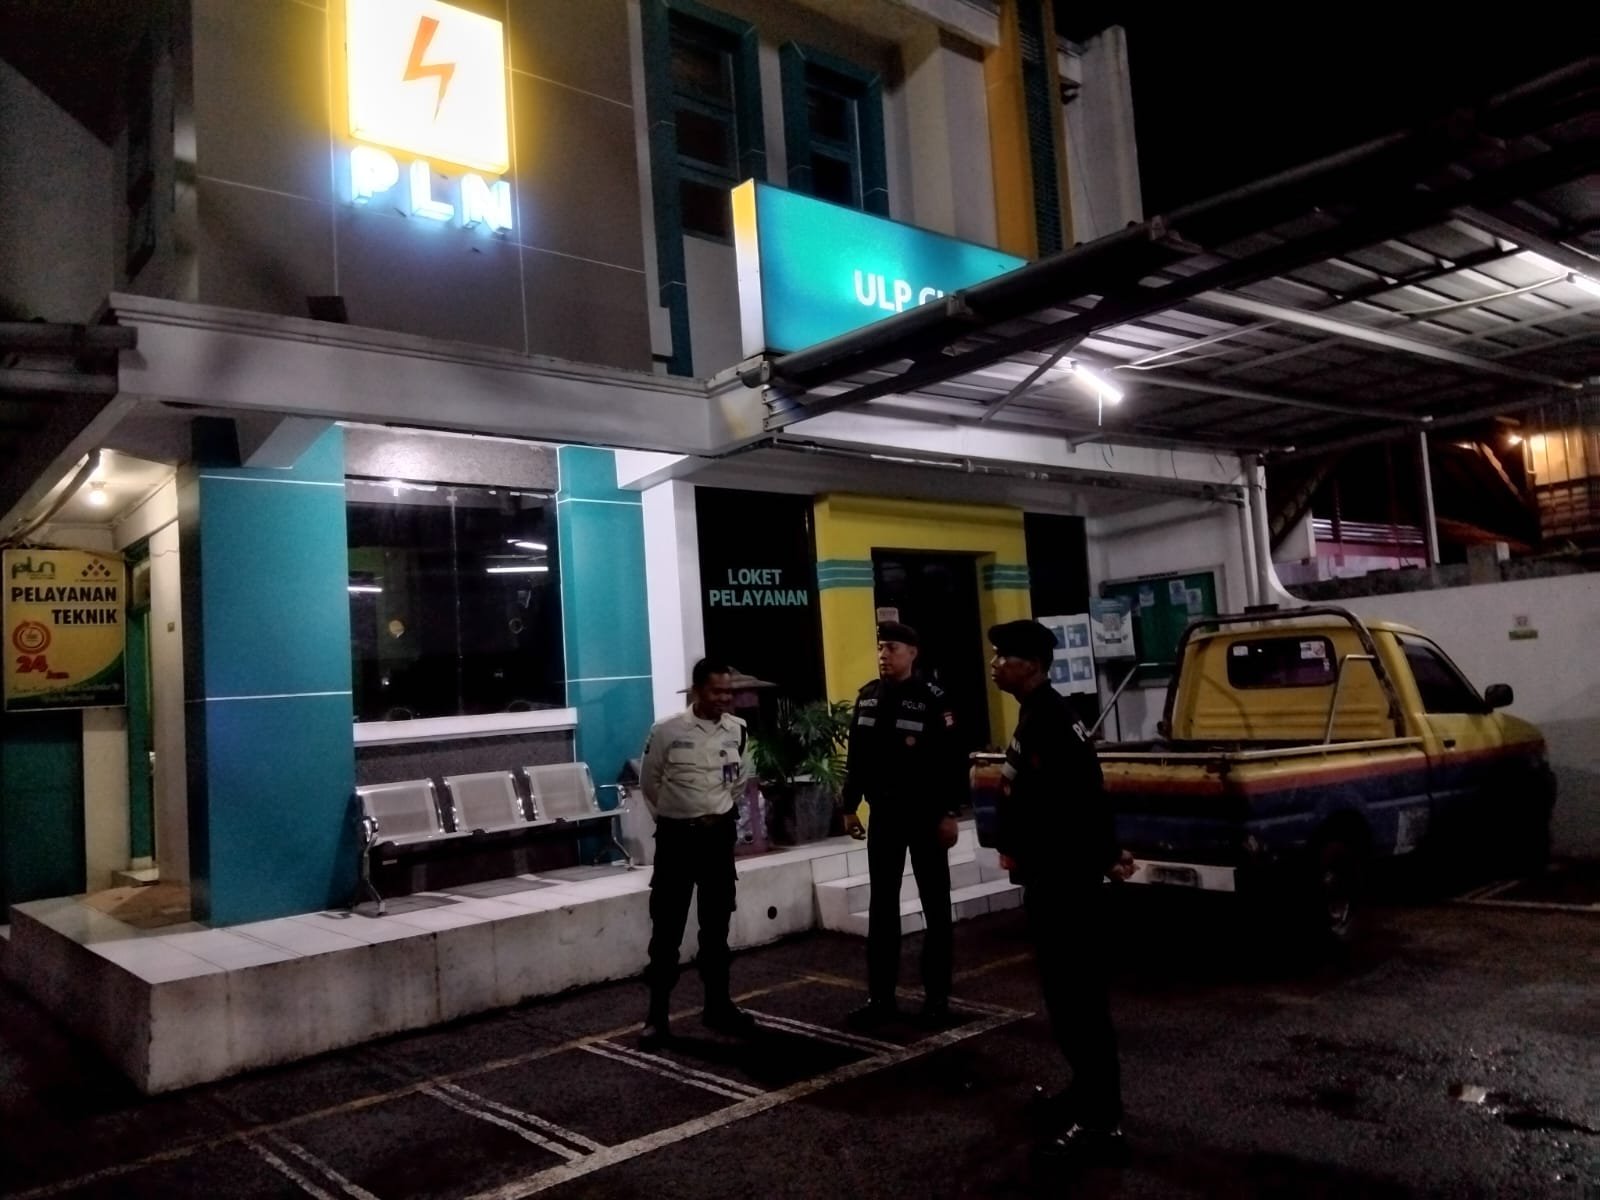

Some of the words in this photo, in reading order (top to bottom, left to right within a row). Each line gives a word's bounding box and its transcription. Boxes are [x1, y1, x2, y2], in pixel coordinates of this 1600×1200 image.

[351, 146, 513, 236] PLN
[854, 269, 912, 313] ULP
[727, 568, 782, 585] LOKET
[11, 586, 117, 602] PELAYANAN
[709, 589, 808, 607] PELAYANAN
[52, 609, 118, 625] TEKNIK
[16, 655, 48, 673] 24
